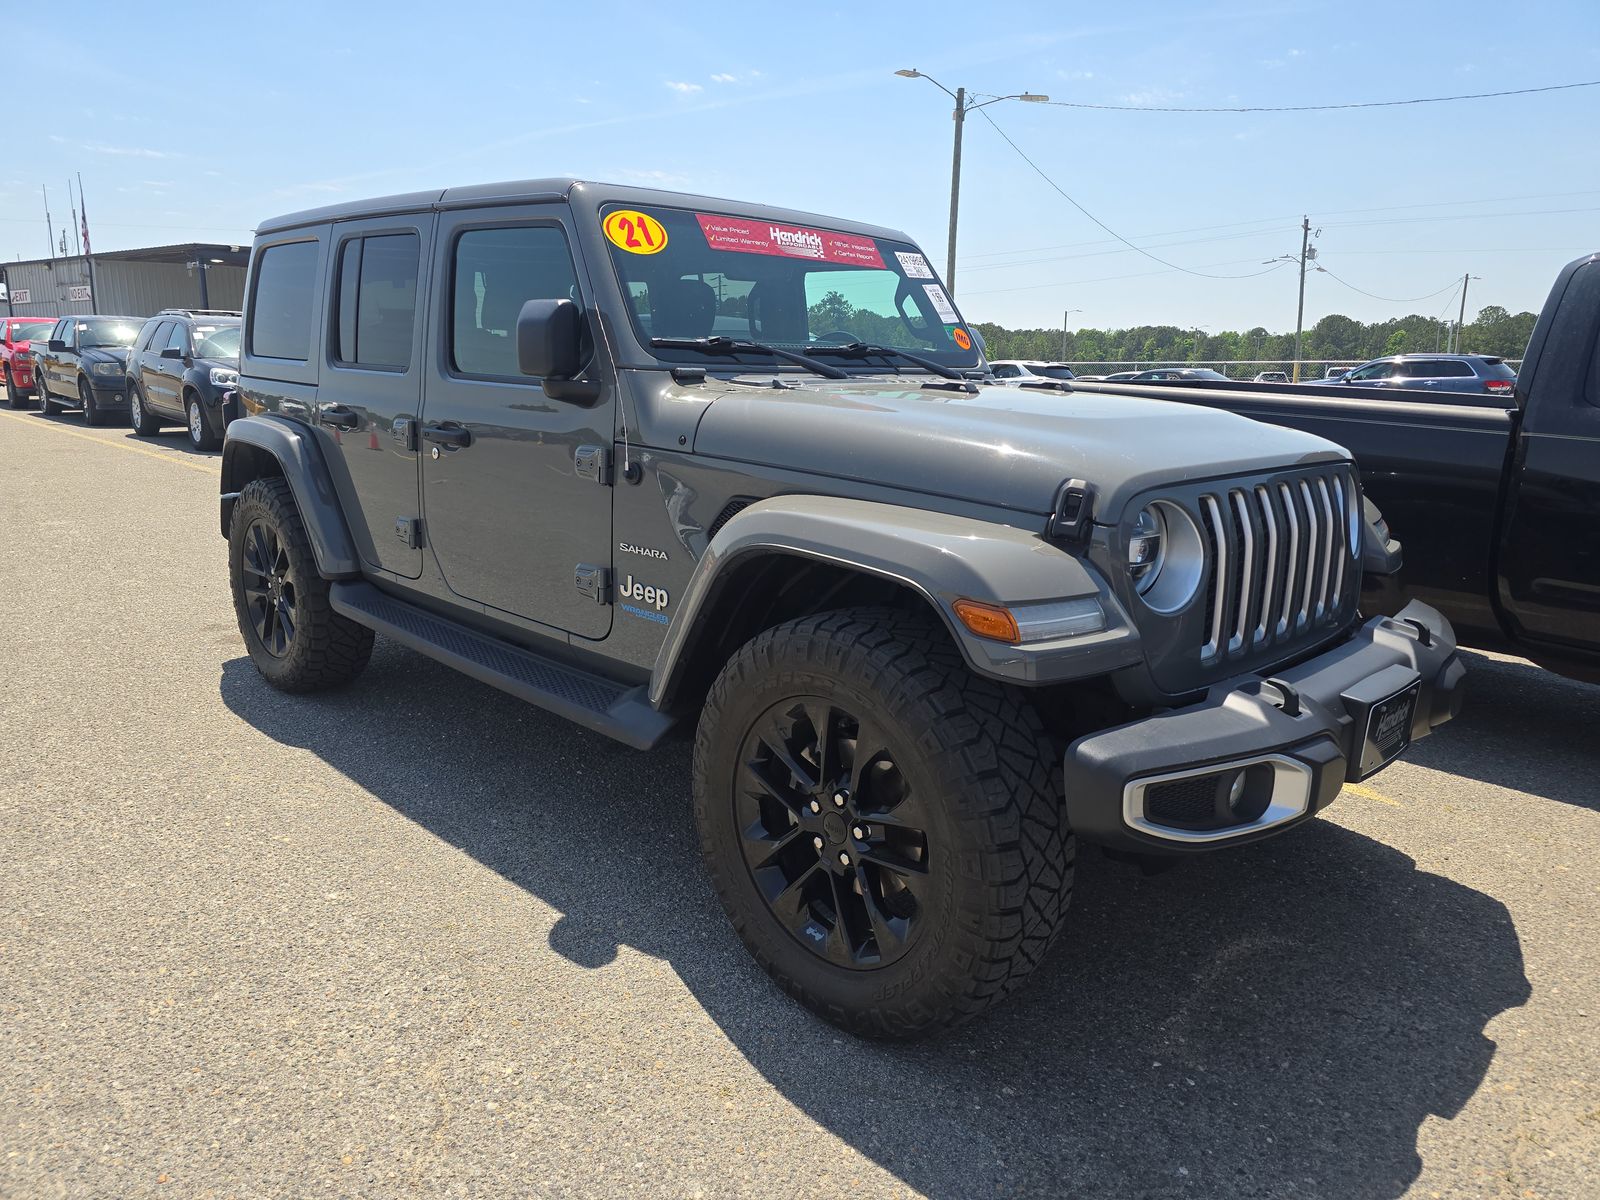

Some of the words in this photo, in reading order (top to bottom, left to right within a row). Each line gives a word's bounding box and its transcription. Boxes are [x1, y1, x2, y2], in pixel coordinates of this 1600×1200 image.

[618, 216, 655, 248] 21
[710, 224, 728, 233] Value
[715, 235, 739, 243] Limited
[769, 226, 823, 246] Hendrick
[15, 291, 28, 302] EXIT
[77, 288, 88, 299] EXIT
[619, 542, 669, 560] SAHARA
[619, 574, 669, 611] Jeep
